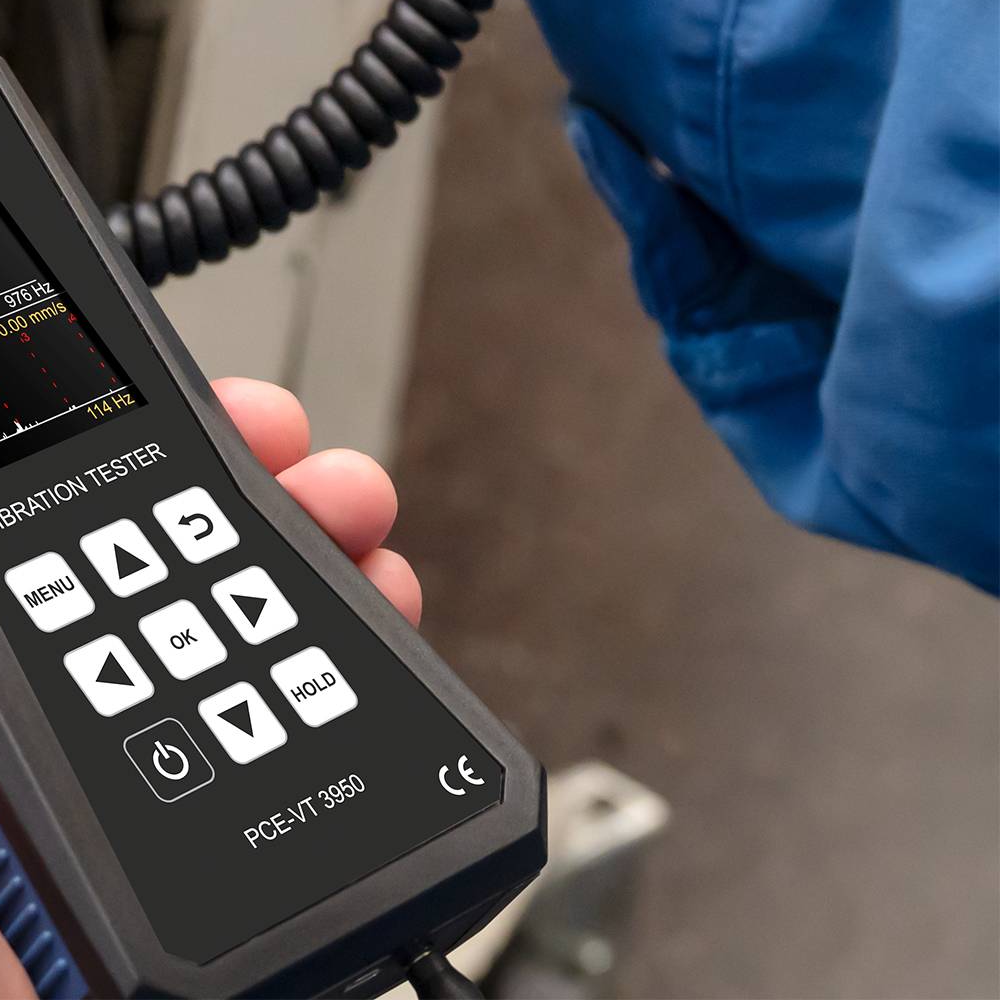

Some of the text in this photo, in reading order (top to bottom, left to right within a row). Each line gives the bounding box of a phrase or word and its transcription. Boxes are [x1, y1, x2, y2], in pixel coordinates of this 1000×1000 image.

[3, 281, 55, 308] 976 Hz
[28, 301, 67, 325] mm/s
[86, 391, 136, 420] 114 Hz
[84, 442, 167, 487] TESTER
[23, 575, 75, 608] MENU
[169, 628, 198, 650] OK
[290, 671, 336, 703] HOLD
[243, 773, 365, 849] PCE-VT 3950
